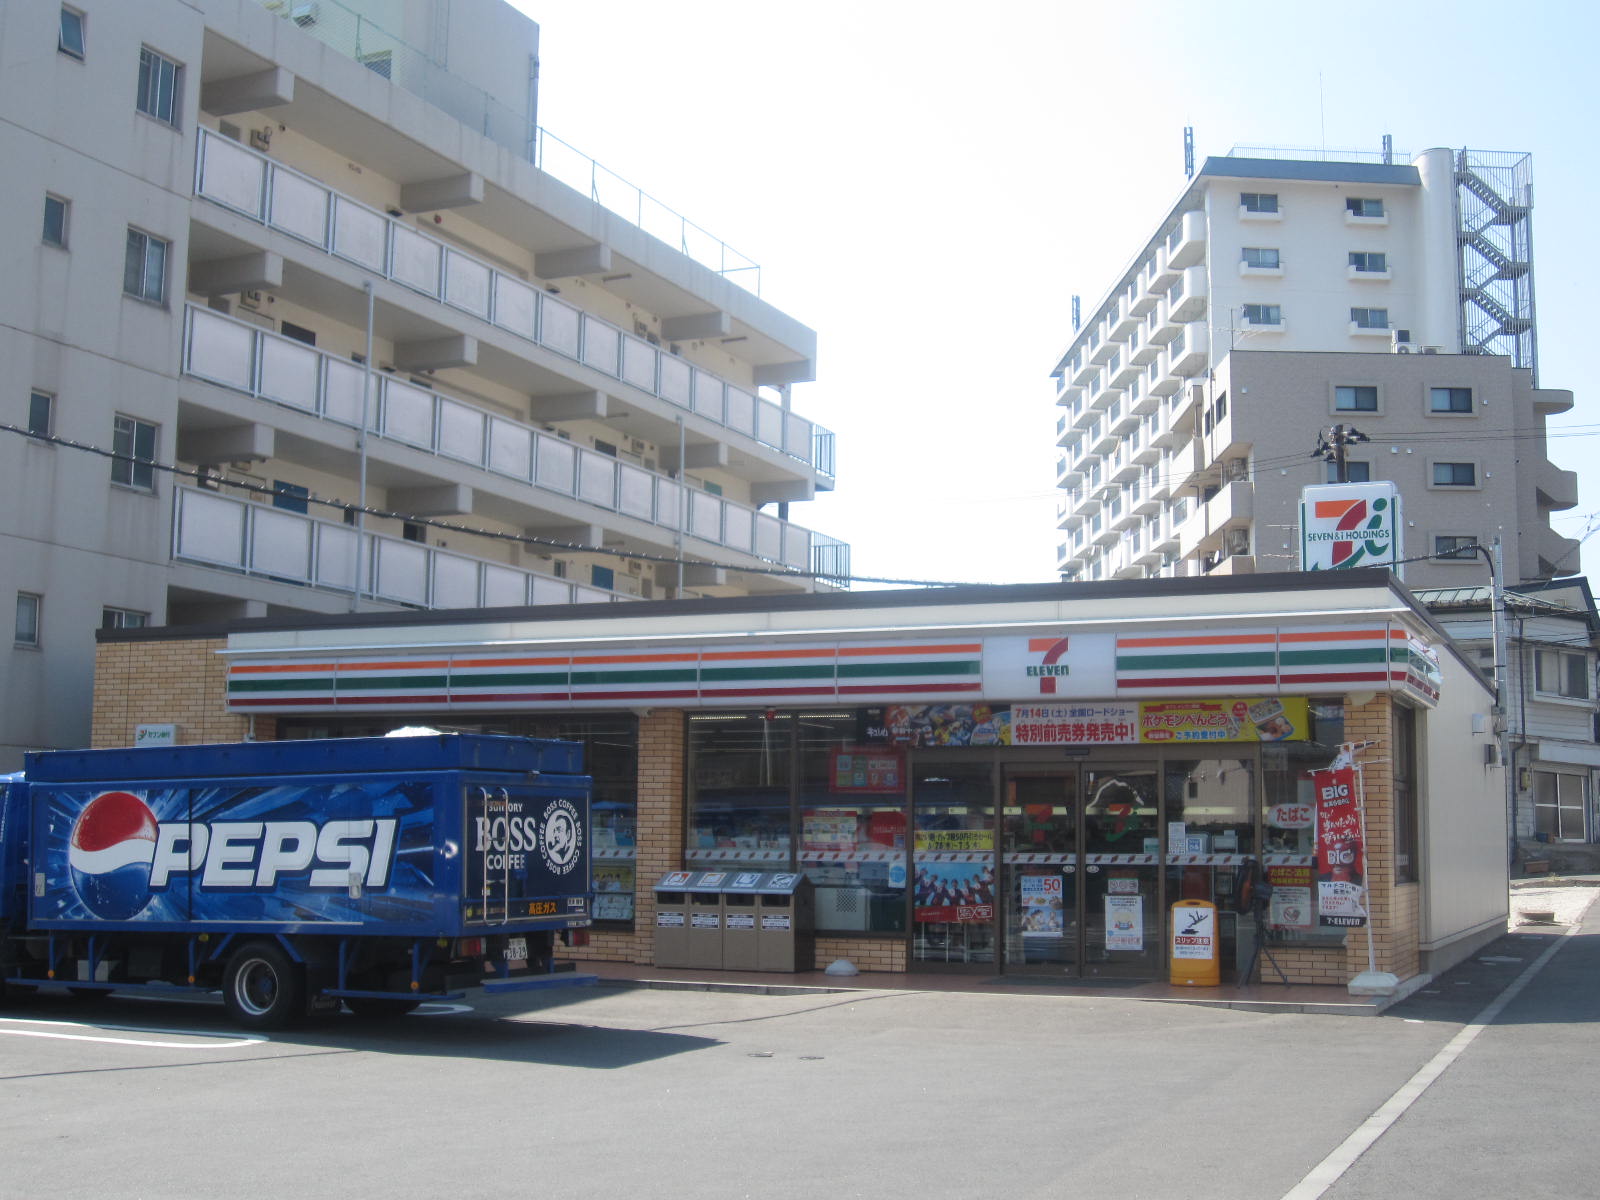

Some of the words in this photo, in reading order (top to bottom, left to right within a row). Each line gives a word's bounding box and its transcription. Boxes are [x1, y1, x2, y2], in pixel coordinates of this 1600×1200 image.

[1345, 529, 1390, 540] HOLDINGS
[1276, 807, 1311, 822] たばこ
[475, 816, 537, 852] BOSS
[148, 818, 398, 888] PEPSI
[1043, 878, 1061, 892] 50
[528, 902, 558, 915] 高圧ガス
